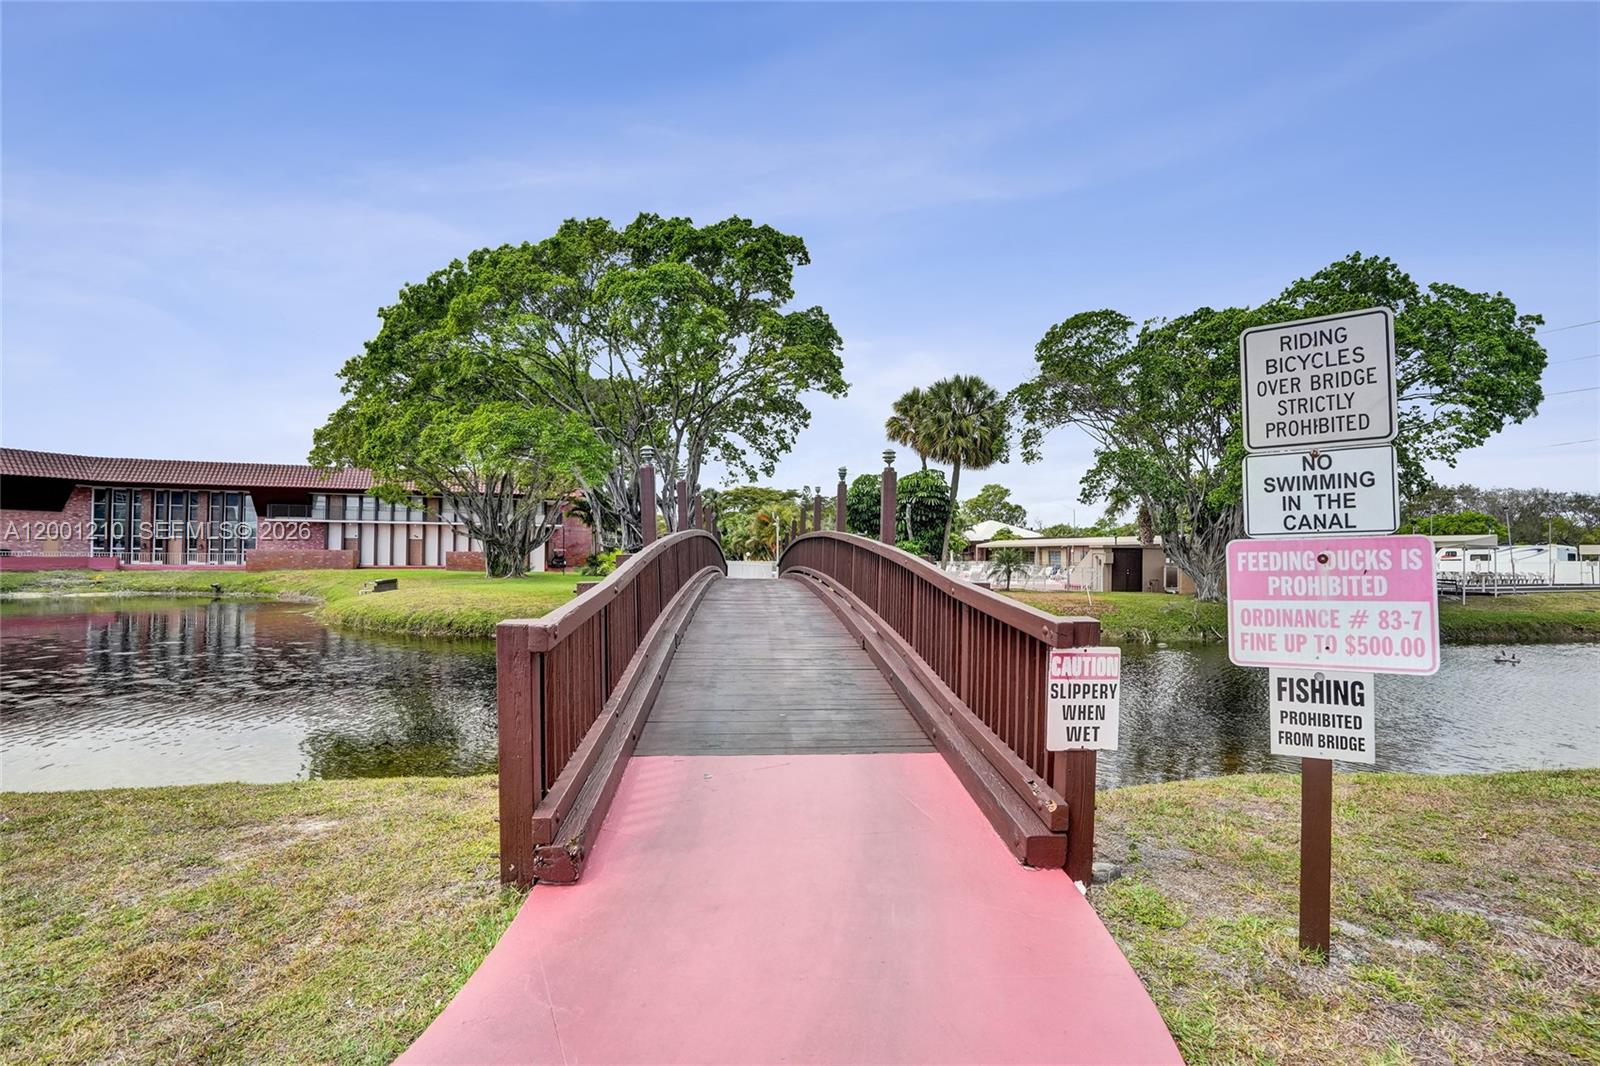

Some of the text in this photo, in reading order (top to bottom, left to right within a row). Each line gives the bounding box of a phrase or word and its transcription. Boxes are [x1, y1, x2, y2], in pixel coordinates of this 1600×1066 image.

[1280, 327, 1348, 351] RIDING
[1266, 347, 1365, 375] BICYCLES
[1257, 367, 1377, 397] OVER BRIDGE
[1277, 392, 1355, 416] STRICTLY
[1266, 414, 1370, 438] PROHIBITED
[1303, 454, 1332, 471] NO
[1264, 471, 1375, 493] SWIMMING
[1282, 493, 1356, 511] IN THE
[1284, 513, 1357, 531] CANAL
[1237, 548, 1422, 571] FEEDING DUCKS IS
[1268, 576, 1388, 596] PROHIBITED
[1240, 608, 1422, 631] ORDINANCE # 83-7
[1240, 633, 1425, 657] FINE UP TO $500.00
[1051, 656, 1118, 676] CAUTION
[1051, 683, 1117, 699] SLIPPERY
[1277, 677, 1365, 707] FISHING
[1062, 705, 1105, 720] WHEN
[1280, 711, 1362, 730] PROHIBITED
[1066, 726, 1100, 741] WET
[1278, 731, 1365, 752] FROM BRIDGE
